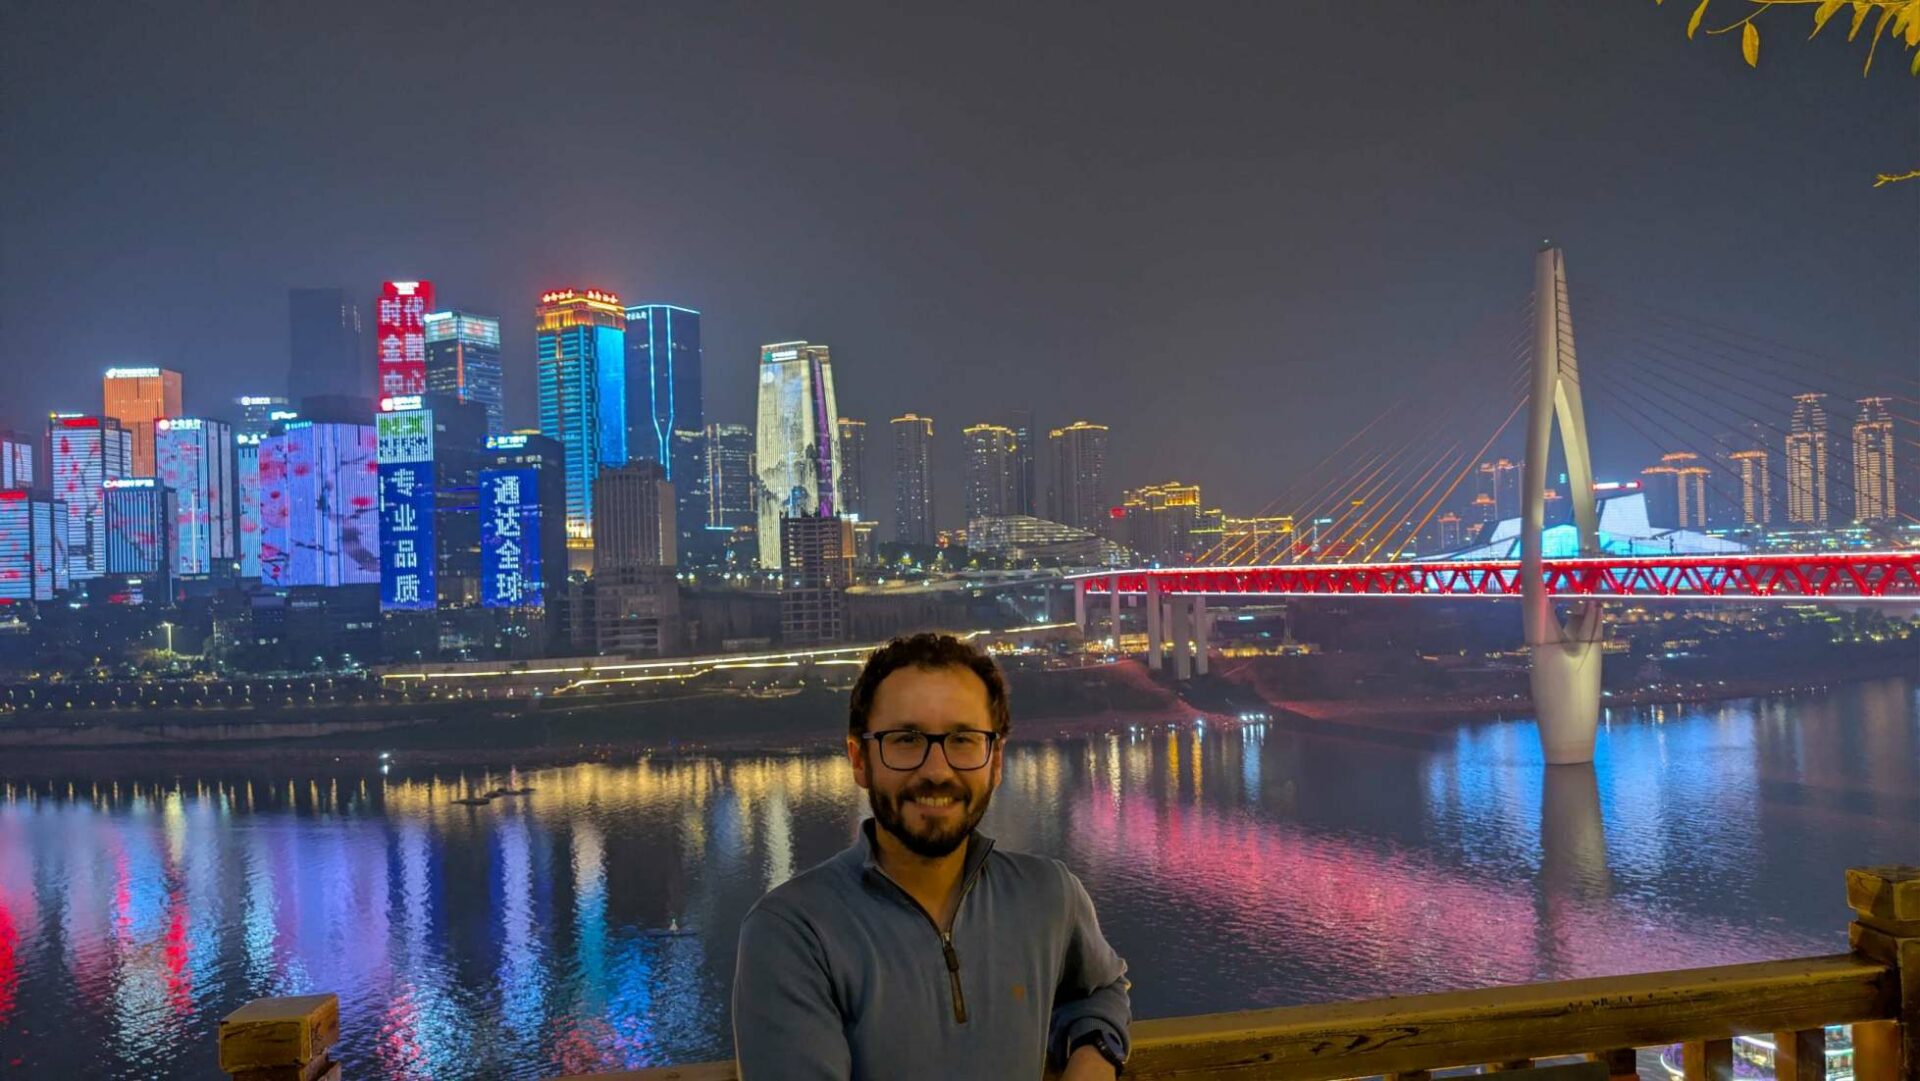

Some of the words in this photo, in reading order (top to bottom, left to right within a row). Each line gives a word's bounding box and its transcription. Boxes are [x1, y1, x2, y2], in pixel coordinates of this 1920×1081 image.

[381, 296, 424, 326] 时代
[391, 468, 420, 603] 专业品质
[493, 476, 522, 602] 通达全球
